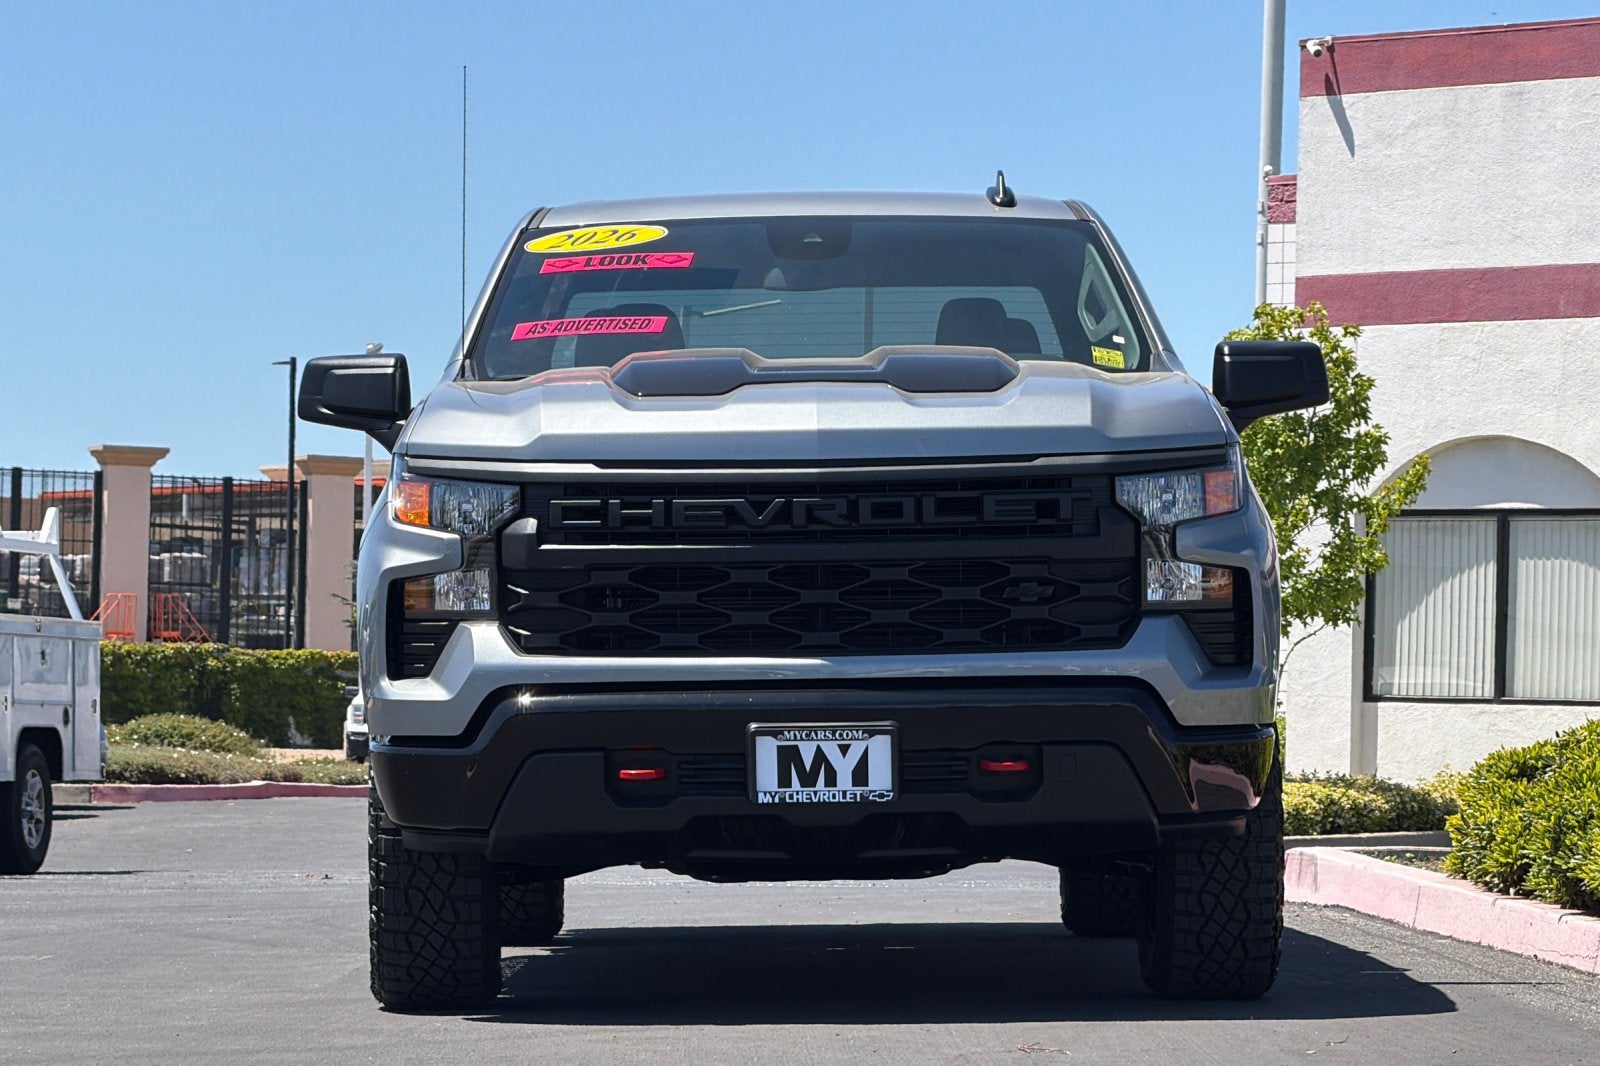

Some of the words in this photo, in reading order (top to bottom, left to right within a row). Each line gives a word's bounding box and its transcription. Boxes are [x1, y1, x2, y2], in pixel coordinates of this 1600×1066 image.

[545, 229, 637, 250] 2026
[583, 254, 650, 268] LOOK
[526, 322, 548, 336] AS
[549, 318, 653, 333] ADVERTISED
[549, 492, 1091, 530] CHEVROLET
[783, 730, 863, 741] MYCARS.COM
[776, 743, 869, 789] MY
[757, 791, 779, 803] MY
[785, 791, 863, 803] CHEVROLET
